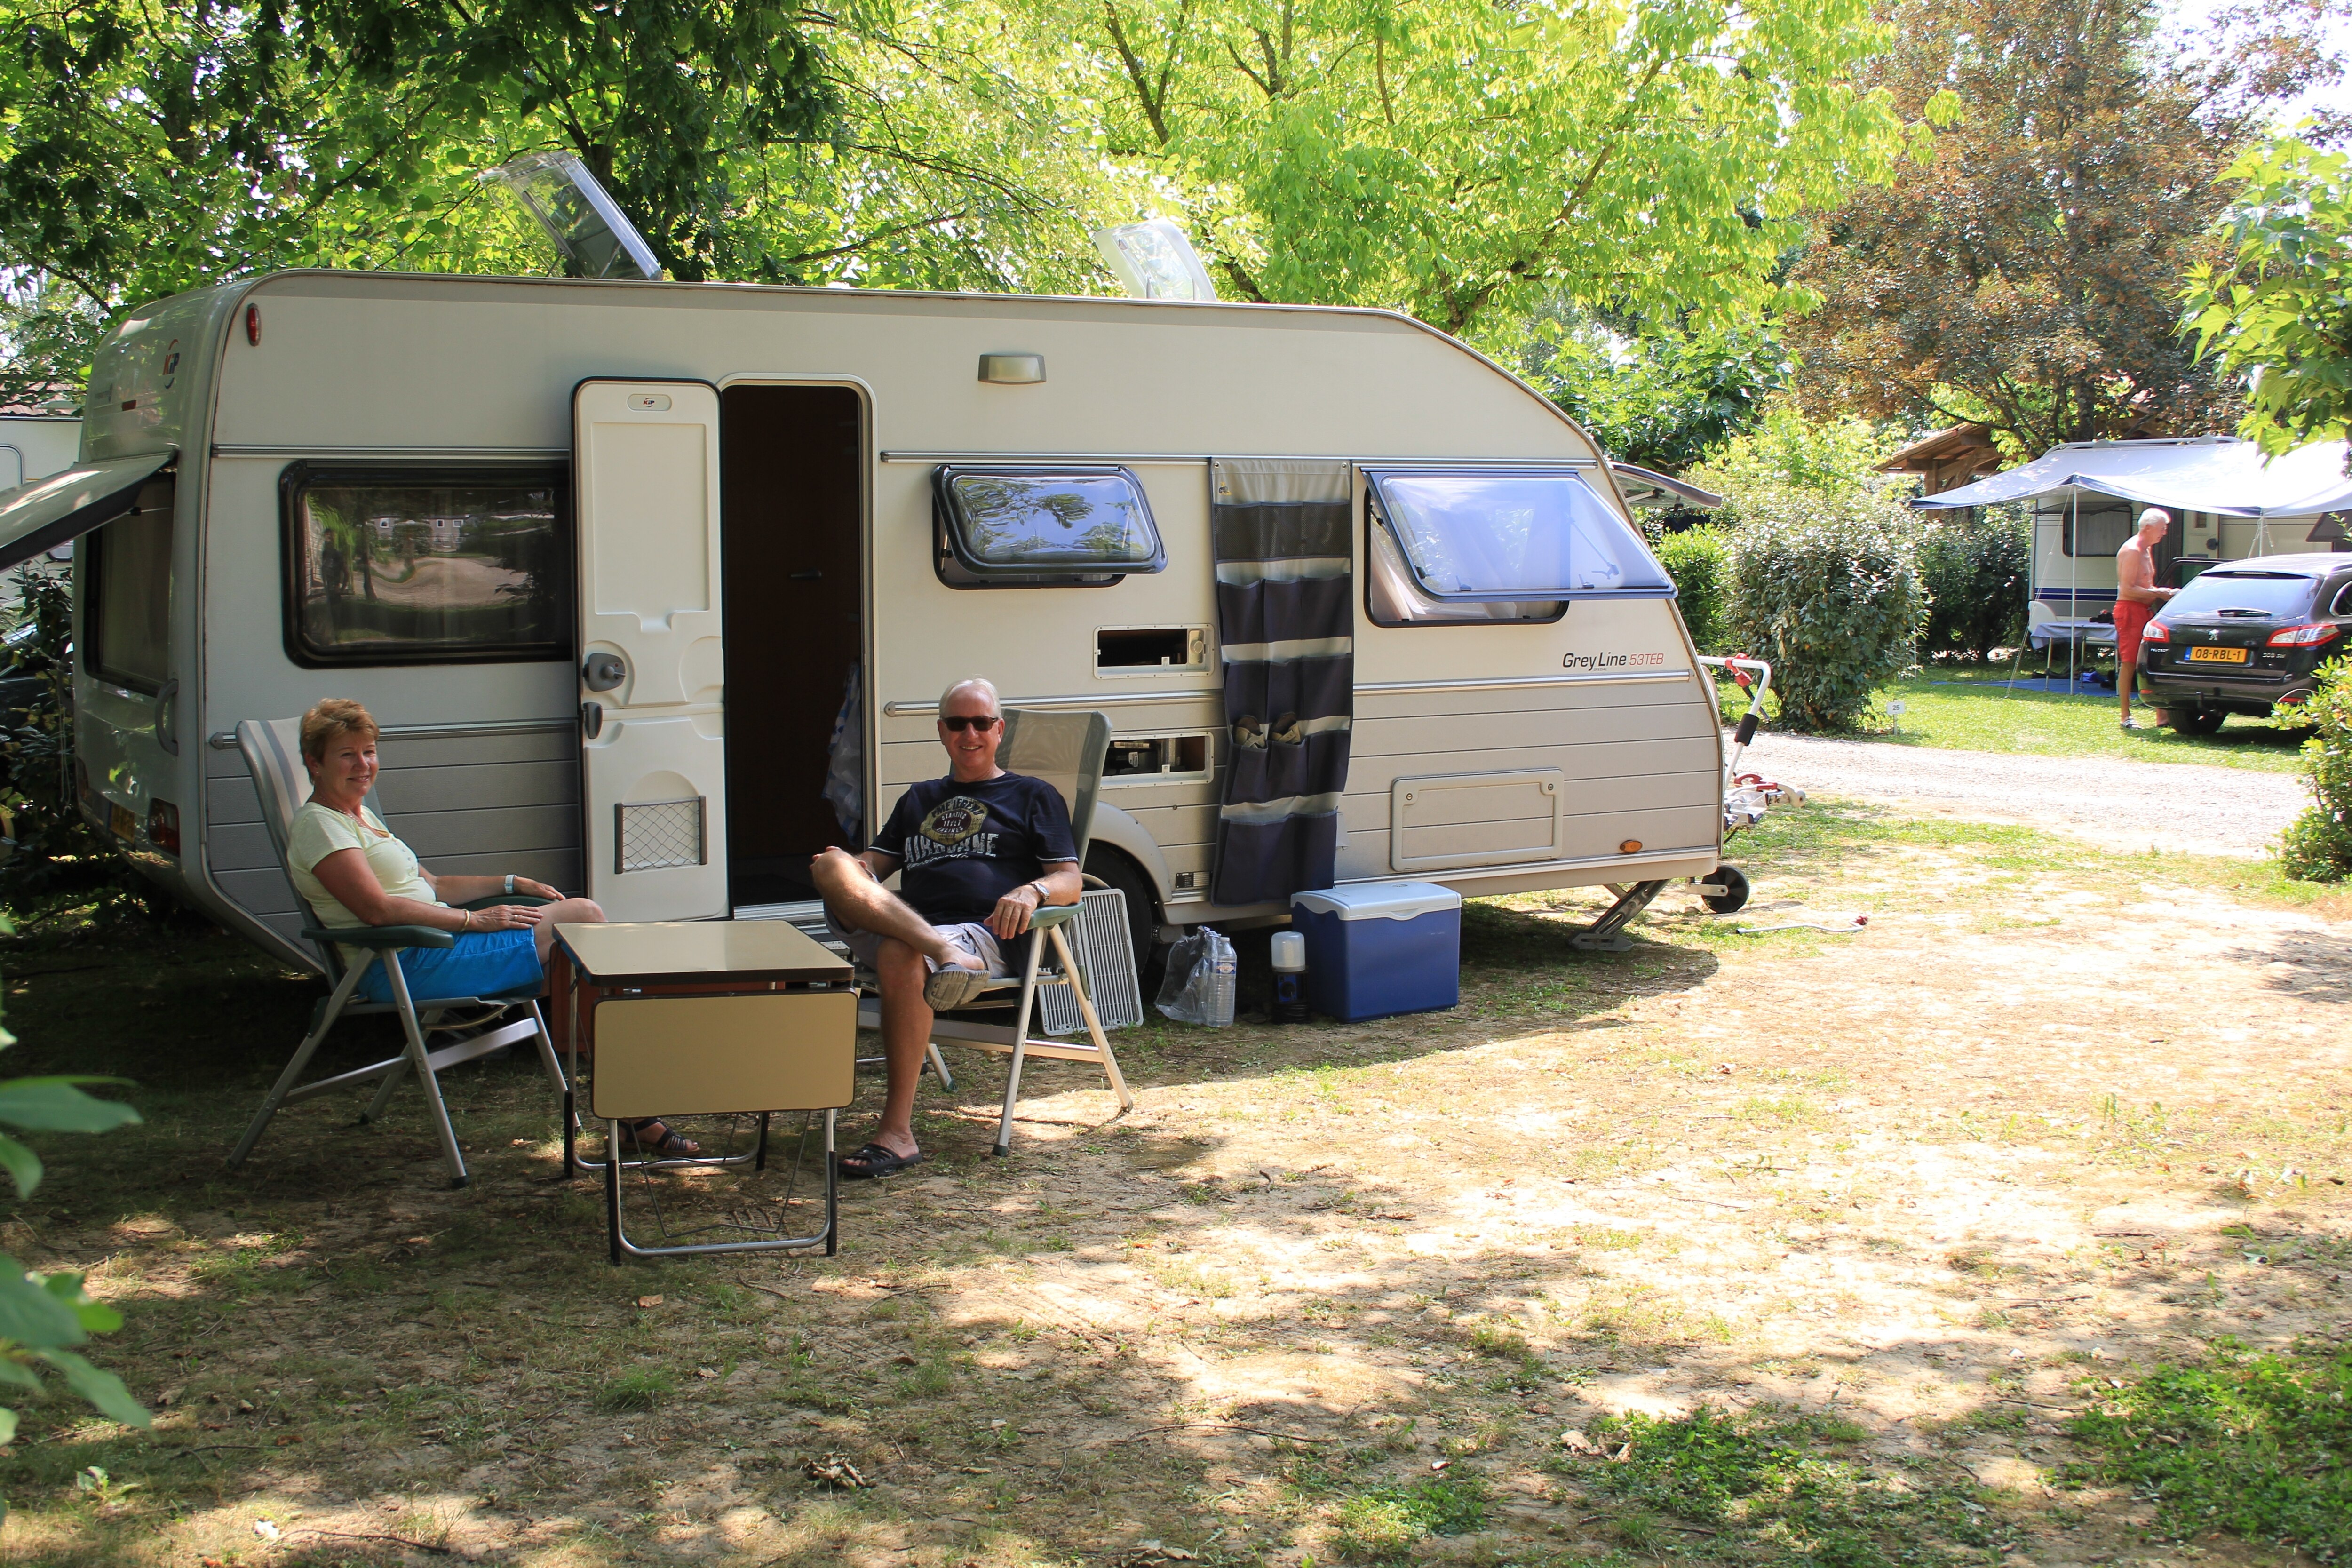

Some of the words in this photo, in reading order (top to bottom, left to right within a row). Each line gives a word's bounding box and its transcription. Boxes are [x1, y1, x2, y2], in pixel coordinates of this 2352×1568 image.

[1629, 653, 1664, 666] 53TEB
[2195, 649, 2241, 661] 08-RBL-1
[942, 811, 967, 820] STARTING
